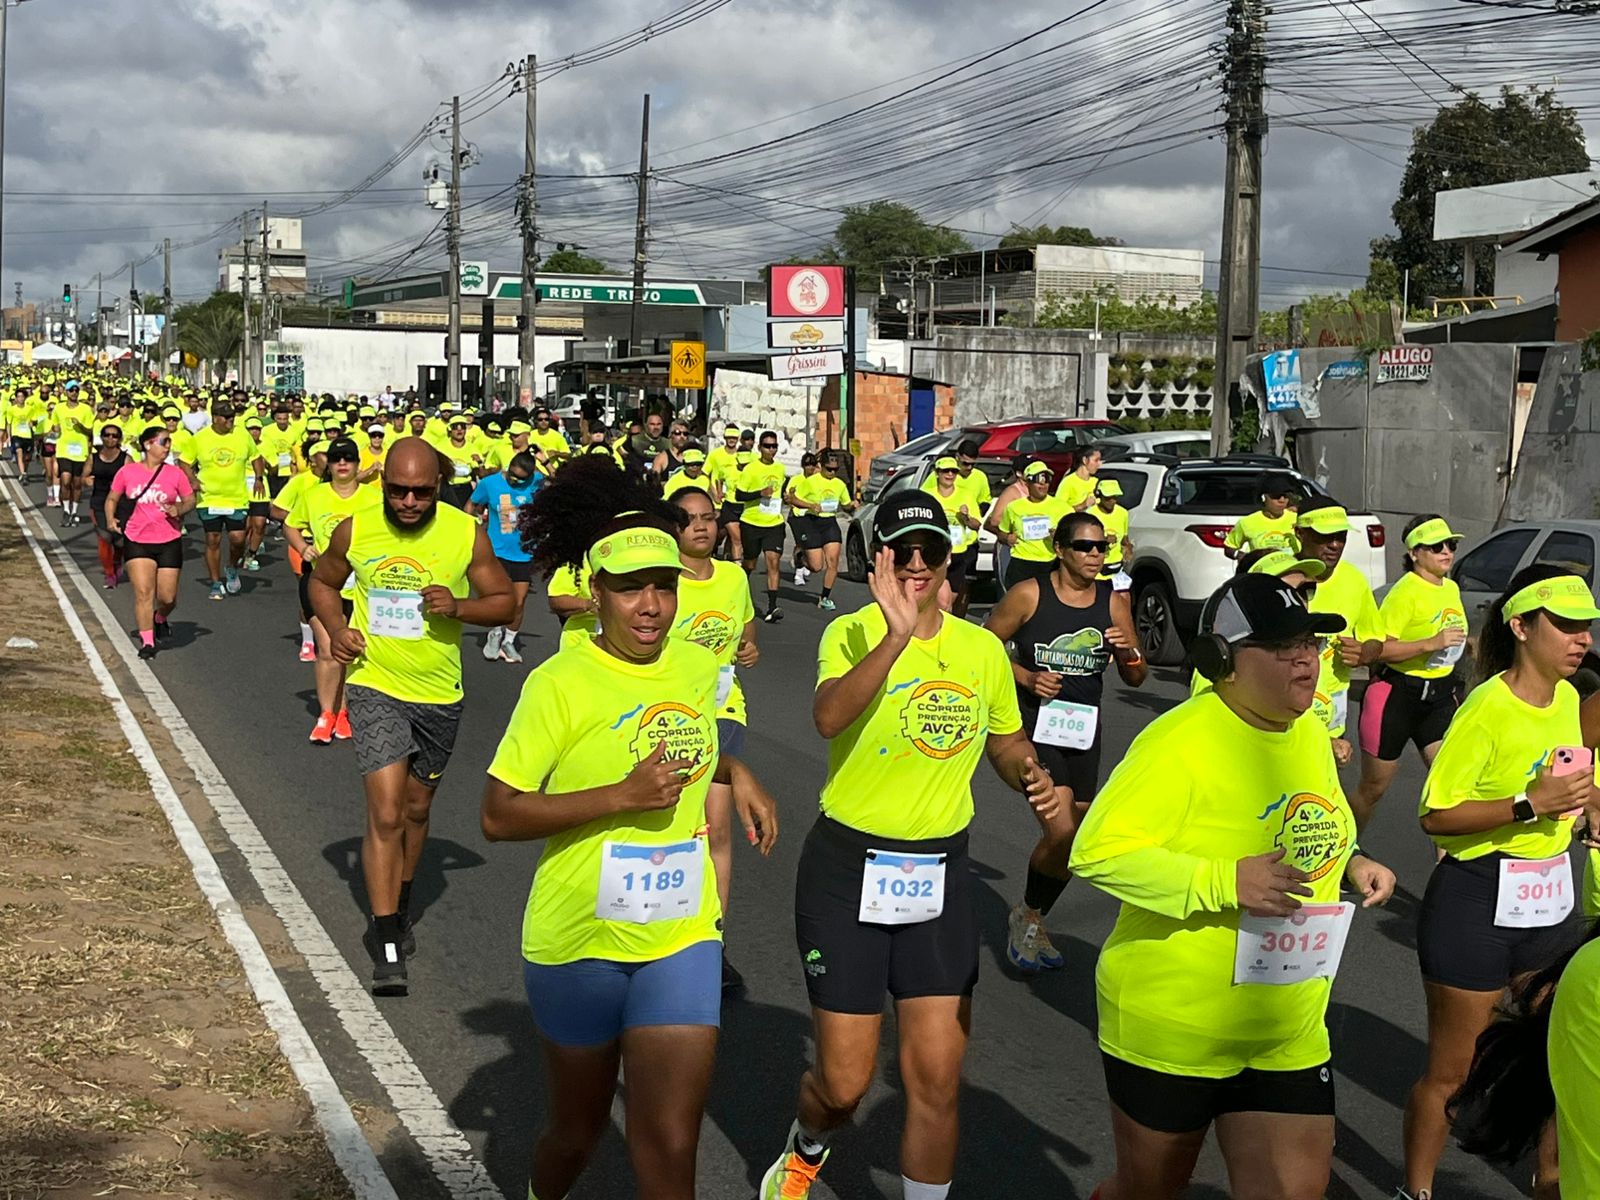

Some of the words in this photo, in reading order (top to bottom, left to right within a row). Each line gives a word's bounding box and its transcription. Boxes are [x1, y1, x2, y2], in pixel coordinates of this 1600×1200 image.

[550, 288, 592, 299] REDE
[1380, 348, 1432, 363] ALUGO
[788, 355, 826, 375] Grissini
[898, 507, 933, 520] VISTHO
[380, 573, 422, 582] CORRIDA
[376, 606, 415, 620] 5456
[918, 703, 970, 713] CORRIDA
[918, 713, 970, 723] PREVENÇÃO
[1048, 716, 1084, 732] 5108
[648, 727, 702, 738] CORRIDA
[921, 723, 954, 734] AVC
[660, 749, 689, 763] AVC
[1292, 821, 1337, 833] CORRIDA
[1293, 832, 1339, 844] PREVENÇÃO
[1295, 844, 1322, 859] AVC
[623, 869, 684, 891] 1189
[877, 878, 933, 897] 1032
[1517, 880, 1562, 900] 3011
[1260, 932, 1328, 952] 3012
